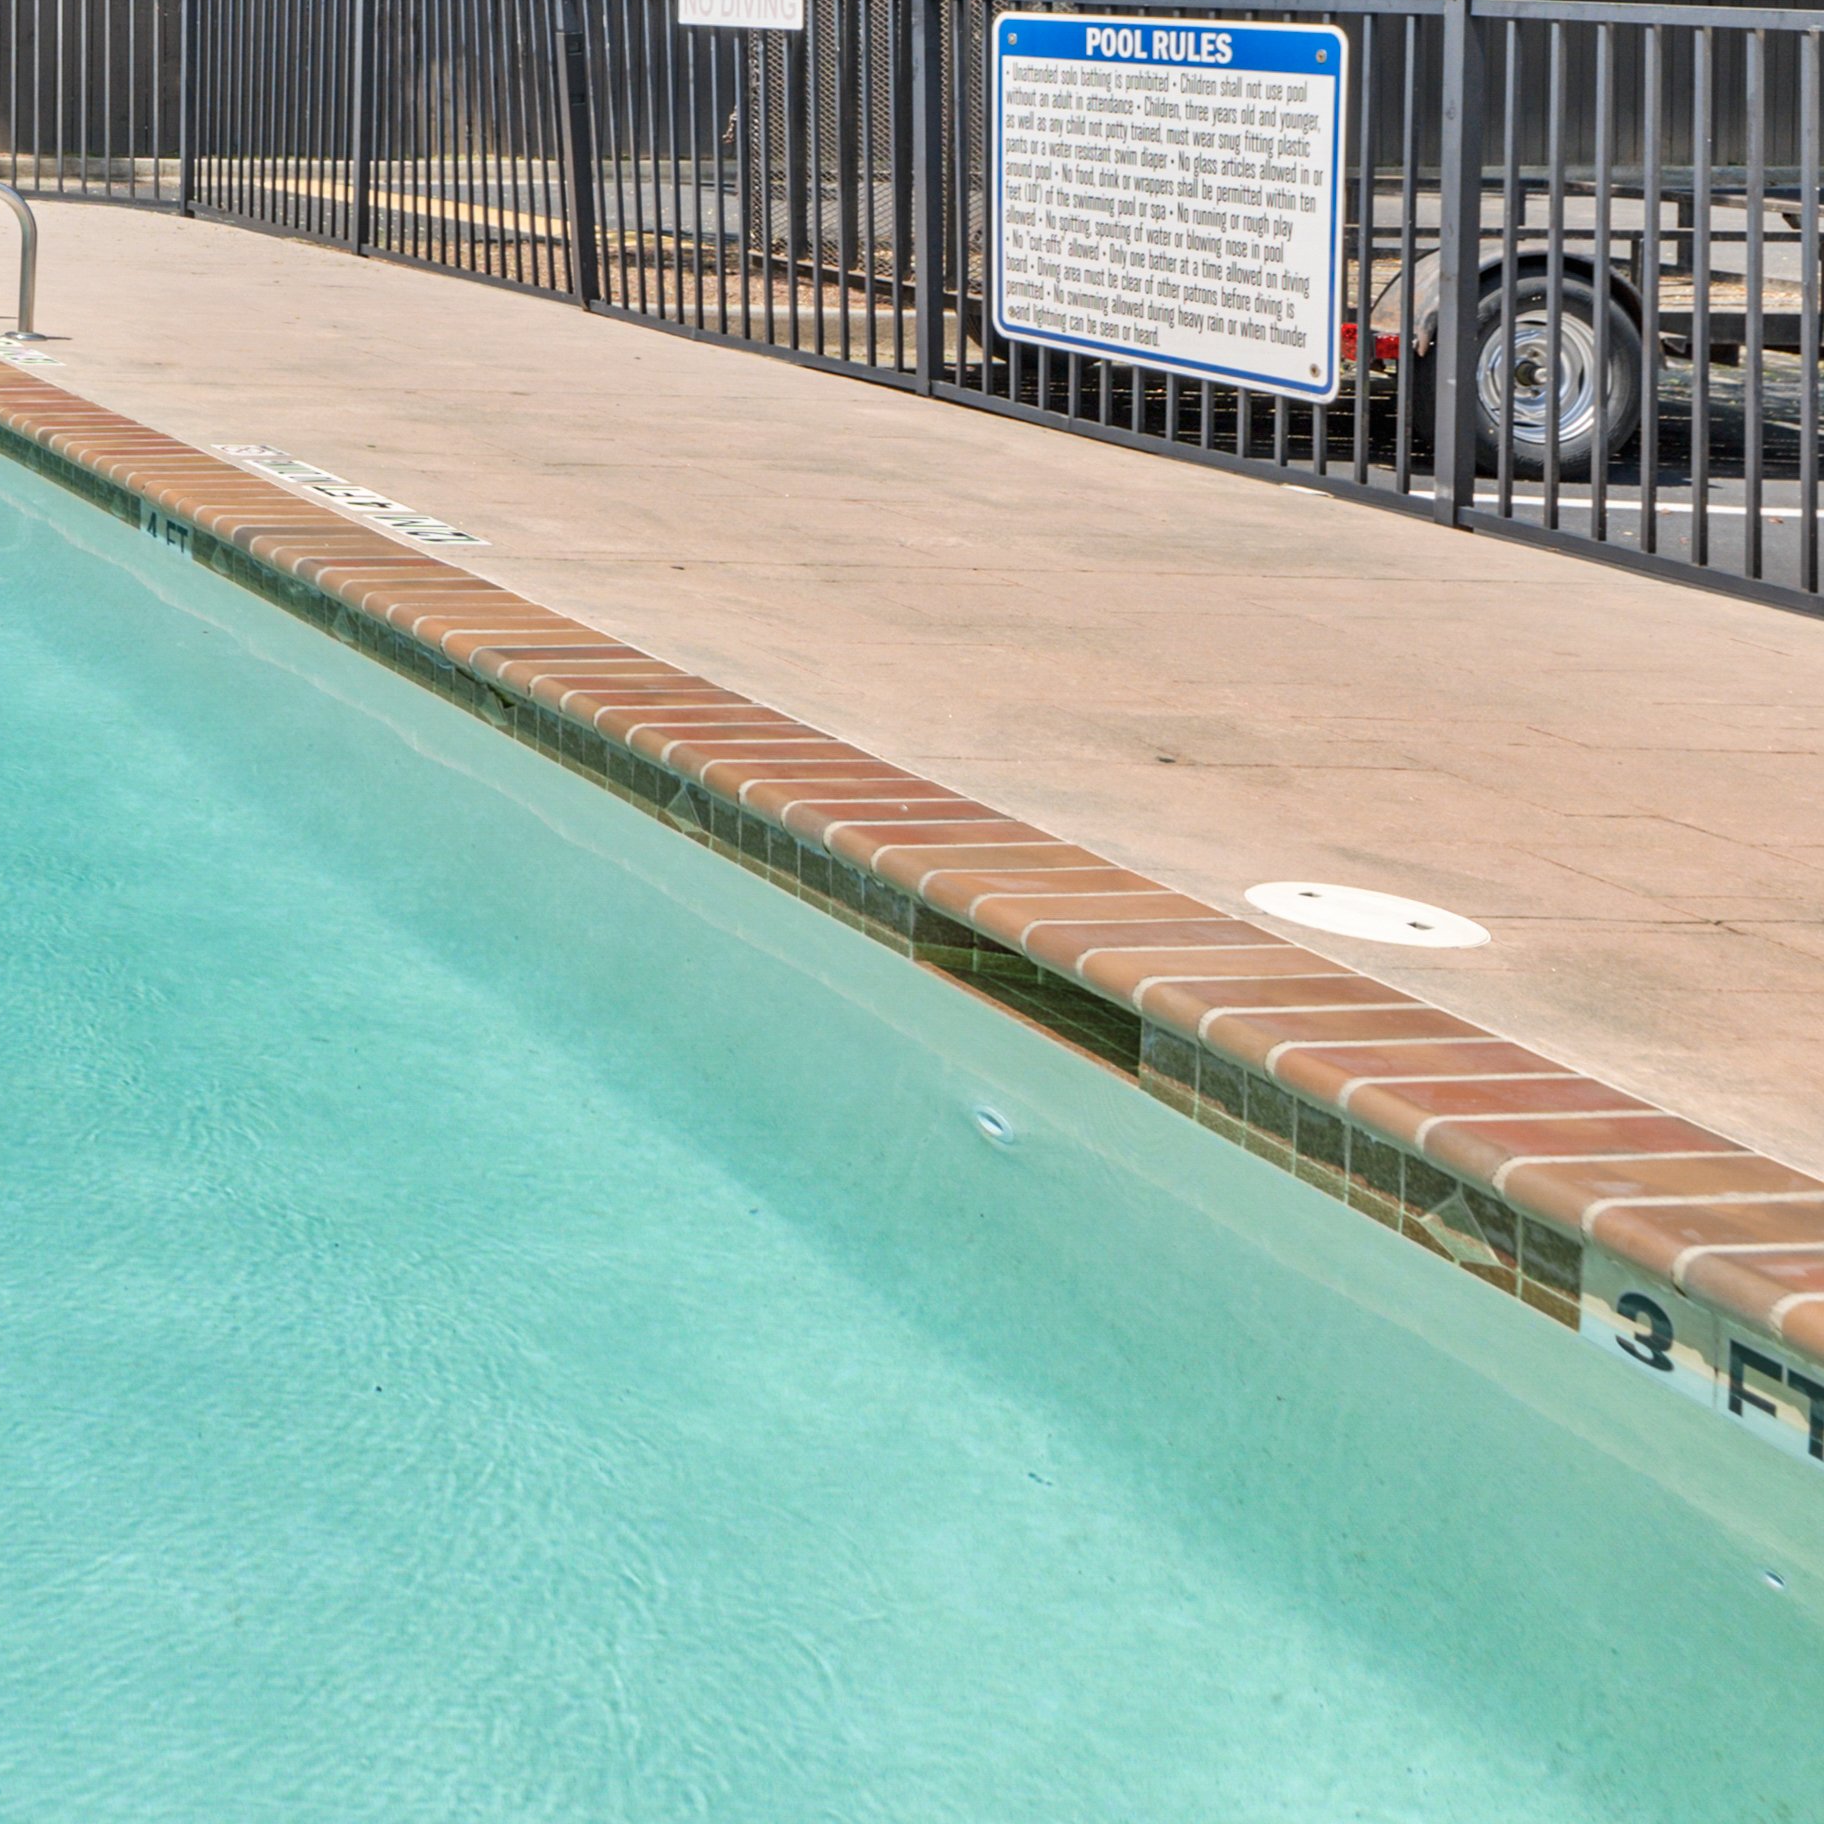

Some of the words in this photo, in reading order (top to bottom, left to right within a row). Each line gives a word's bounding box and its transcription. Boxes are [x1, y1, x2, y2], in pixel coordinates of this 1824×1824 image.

[1086, 27, 1147, 58] POOL
[1152, 30, 1232, 64] RULES
[1007, 85, 1035, 106] without
[1039, 91, 1048, 107] an
[1052, 88, 1072, 109] adult
[1076, 91, 1082, 110] in
[1086, 91, 1133, 115] attendance
[1185, 99, 1208, 121] three
[1212, 105, 1237, 128] years
[1241, 103, 1254, 126] old
[1259, 105, 1275, 127] and
[1014, 61, 1057, 84] Unattended
[1062, 65, 1076, 85] solo
[1081, 66, 1111, 92] bathing
[1115, 69, 1122, 89] is
[1126, 69, 1168, 96] prohibited
[1180, 73, 1216, 96] Children
[1220, 75, 1241, 98] shall
[1246, 79, 1261, 99] not
[1266, 82, 1282, 101] use
[1287, 80, 1306, 107] pool
[1006, 112, 1014, 128] as
[1018, 109, 1033, 130] well
[1037, 115, 1046, 131] as
[1050, 116, 1062, 137] any
[1066, 114, 1085, 135] child
[1089, 117, 1102, 137] not
[1106, 119, 1127, 143] potty
[1167, 124, 1189, 145] must
[1193, 129, 1215, 148] wear
[1218, 132, 1240, 155] snug
[1244, 130, 1273, 158] fitting
[1277, 133, 1310, 162] plastic
[1006, 133, 1027, 157] pants
[1030, 138, 1038, 154] or
[1041, 139, 1045, 155] a
[1049, 138, 1071, 158] water
[1075, 140, 1110, 163] resistant
[1114, 144, 1136, 165] swim
[1141, 146, 1167, 173] diaper
[1178, 150, 1189, 172] No
[1193, 152, 1217, 179] glass
[1221, 155, 1256, 179] articles
[1259, 159, 1296, 184] allowed
[1300, 163, 1309, 185] in
[1313, 168, 1323, 187] or
[1006, 156, 1031, 178] around
[1035, 159, 1050, 184] pool
[1062, 162, 1071, 183] No
[1099, 167, 1119, 189] drink
[1122, 173, 1130, 190] or
[1133, 174, 1173, 200] wrappers
[1177, 176, 1198, 198] shall
[1201, 179, 1212, 200] be
[1216, 180, 1261, 211] permitted
[1266, 186, 1295, 211] within
[1299, 192, 1315, 213] ten
[1006, 180, 1021, 200] feet
[1045, 185, 1053, 204] of
[1056, 186, 1069, 207] the
[1073, 189, 1114, 217] swimming
[1118, 194, 1135, 220] pool
[1139, 200, 1147, 217] or
[1150, 202, 1165, 224] spa
[1177, 202, 1188, 223] No
[1193, 204, 1226, 233] running
[1230, 212, 1239, 230] or
[1243, 210, 1269, 239] rough
[1273, 214, 1292, 242] play
[1006, 203, 1035, 226] allowed
[1046, 209, 1055, 229] No
[1095, 216, 1130, 244] spouting
[1134, 221, 1143, 242] of
[1146, 224, 1171, 246] water
[1174, 231, 1183, 248] or
[1187, 229, 1221, 258] blowing
[1226, 238, 1247, 258] nose
[1251, 238, 1259, 259] in
[1264, 239, 1283, 267] pool
[1006, 251, 1027, 273] board
[1038, 256, 1060, 282] Diving
[1064, 264, 1080, 282] area
[1084, 265, 1104, 286] must
[1108, 268, 1117, 288] be
[1121, 270, 1141, 293] clear
[1144, 274, 1153, 295] of
[1157, 276, 1180, 299] other
[1183, 282, 1217, 310] patrons
[1221, 286, 1250, 312] before
[1254, 292, 1281, 321] diving
[1286, 298, 1294, 319] is
[1013, 228, 1022, 248] No
[1068, 237, 1098, 260] allowed
[1110, 243, 1126, 269] Only
[1130, 250, 1144, 268] one
[1149, 249, 1176, 273] bather
[1180, 255, 1189, 275] at
[1192, 260, 1198, 277] a
[1201, 258, 1222, 281] time
[1226, 261, 1261, 287] allowed
[1266, 271, 1277, 289] on
[1281, 270, 1309, 299] diving
[166, 519, 188, 554] FT
[1615, 1291, 1674, 1372] 3
[1728, 1339, 1824, 1461] FT
